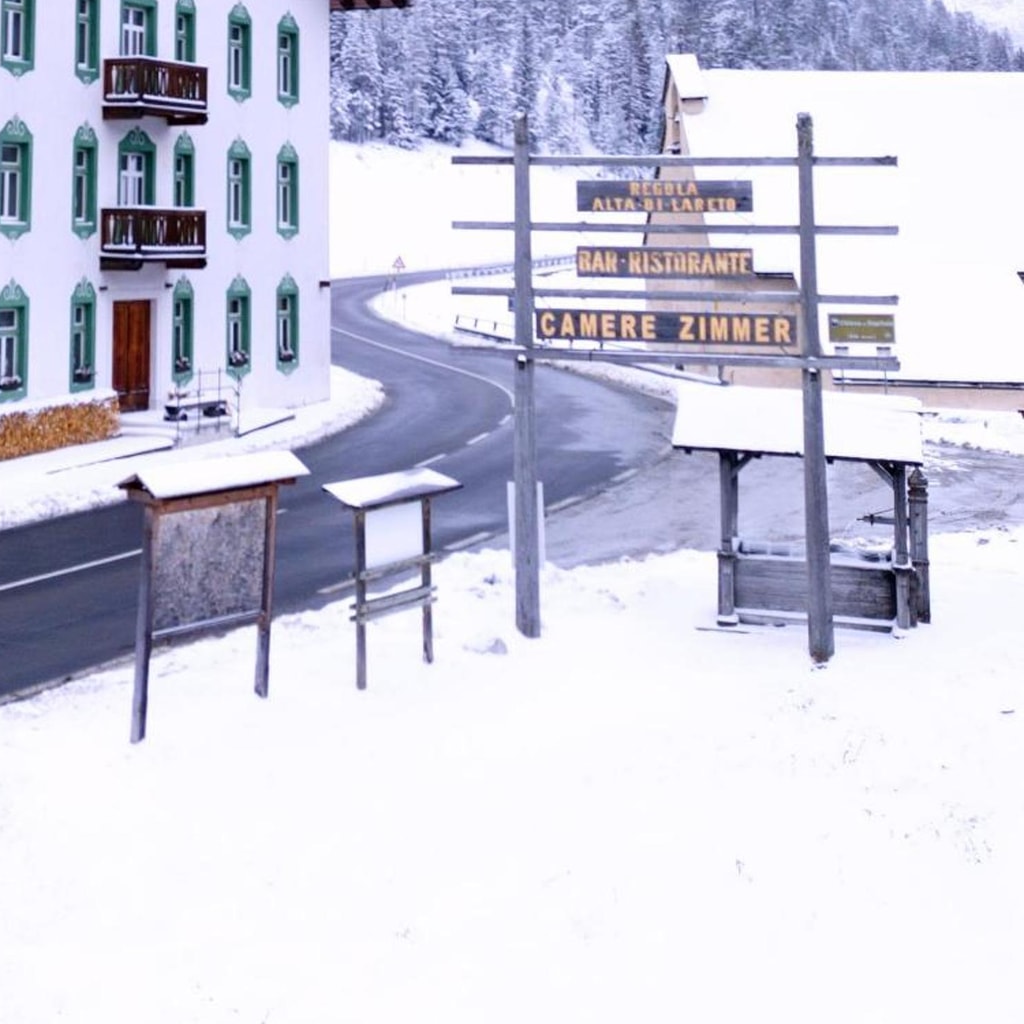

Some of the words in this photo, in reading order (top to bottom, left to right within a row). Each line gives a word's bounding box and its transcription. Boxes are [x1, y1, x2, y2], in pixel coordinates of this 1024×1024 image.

[629, 181, 698, 196] REGOLA
[540, 312, 657, 339] CAMERE
[678, 315, 792, 343] ZIMMER
